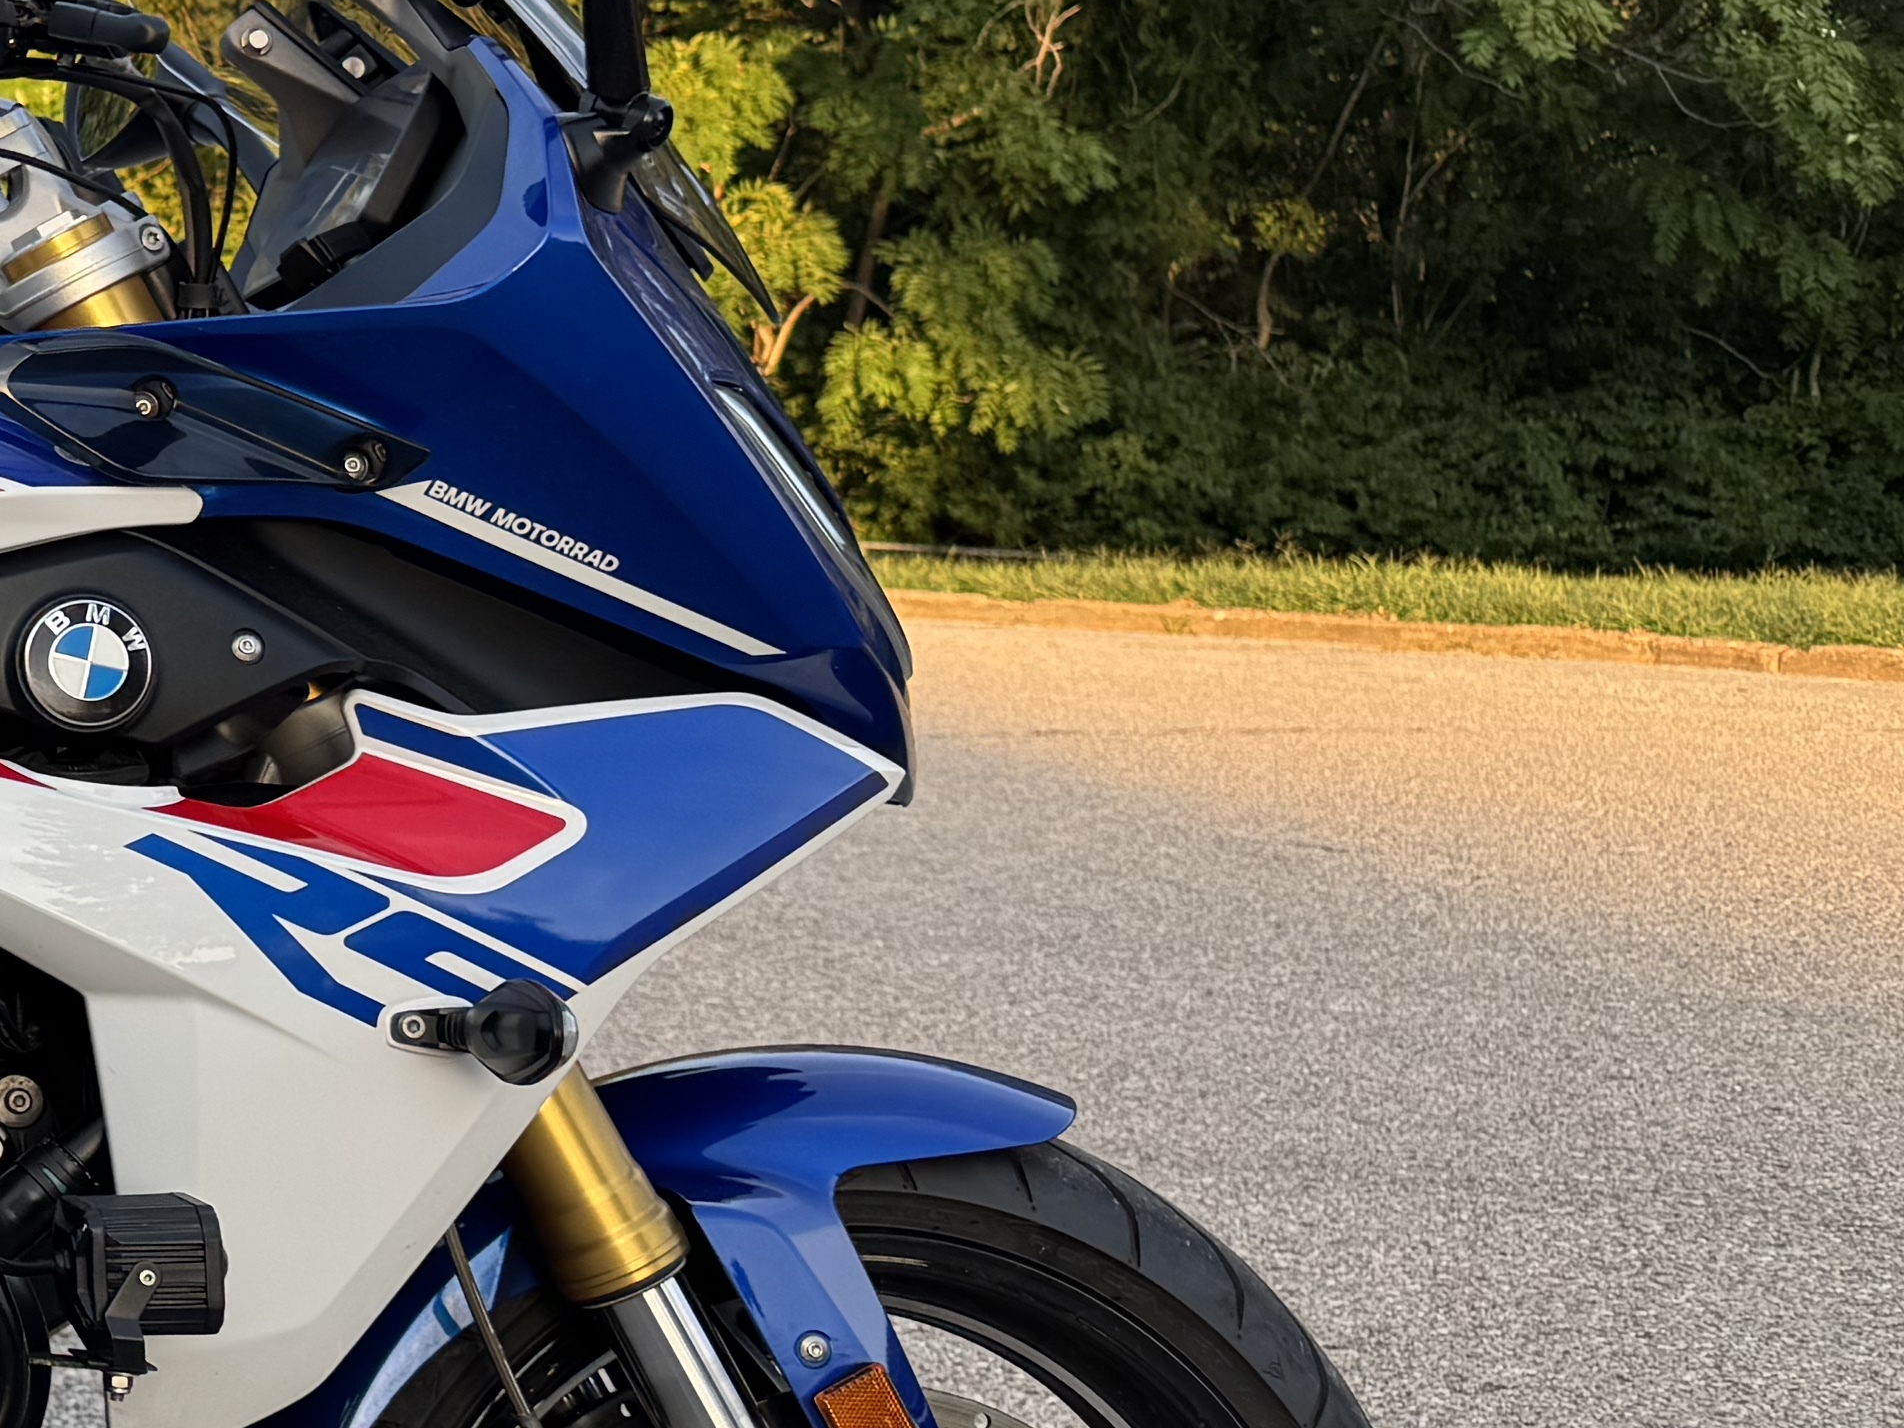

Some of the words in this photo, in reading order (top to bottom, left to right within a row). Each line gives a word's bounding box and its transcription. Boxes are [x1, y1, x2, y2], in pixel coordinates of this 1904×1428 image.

[428, 480, 492, 517] BMW
[490, 508, 620, 572] MOTORRAD
[45, 603, 146, 652] BMW
